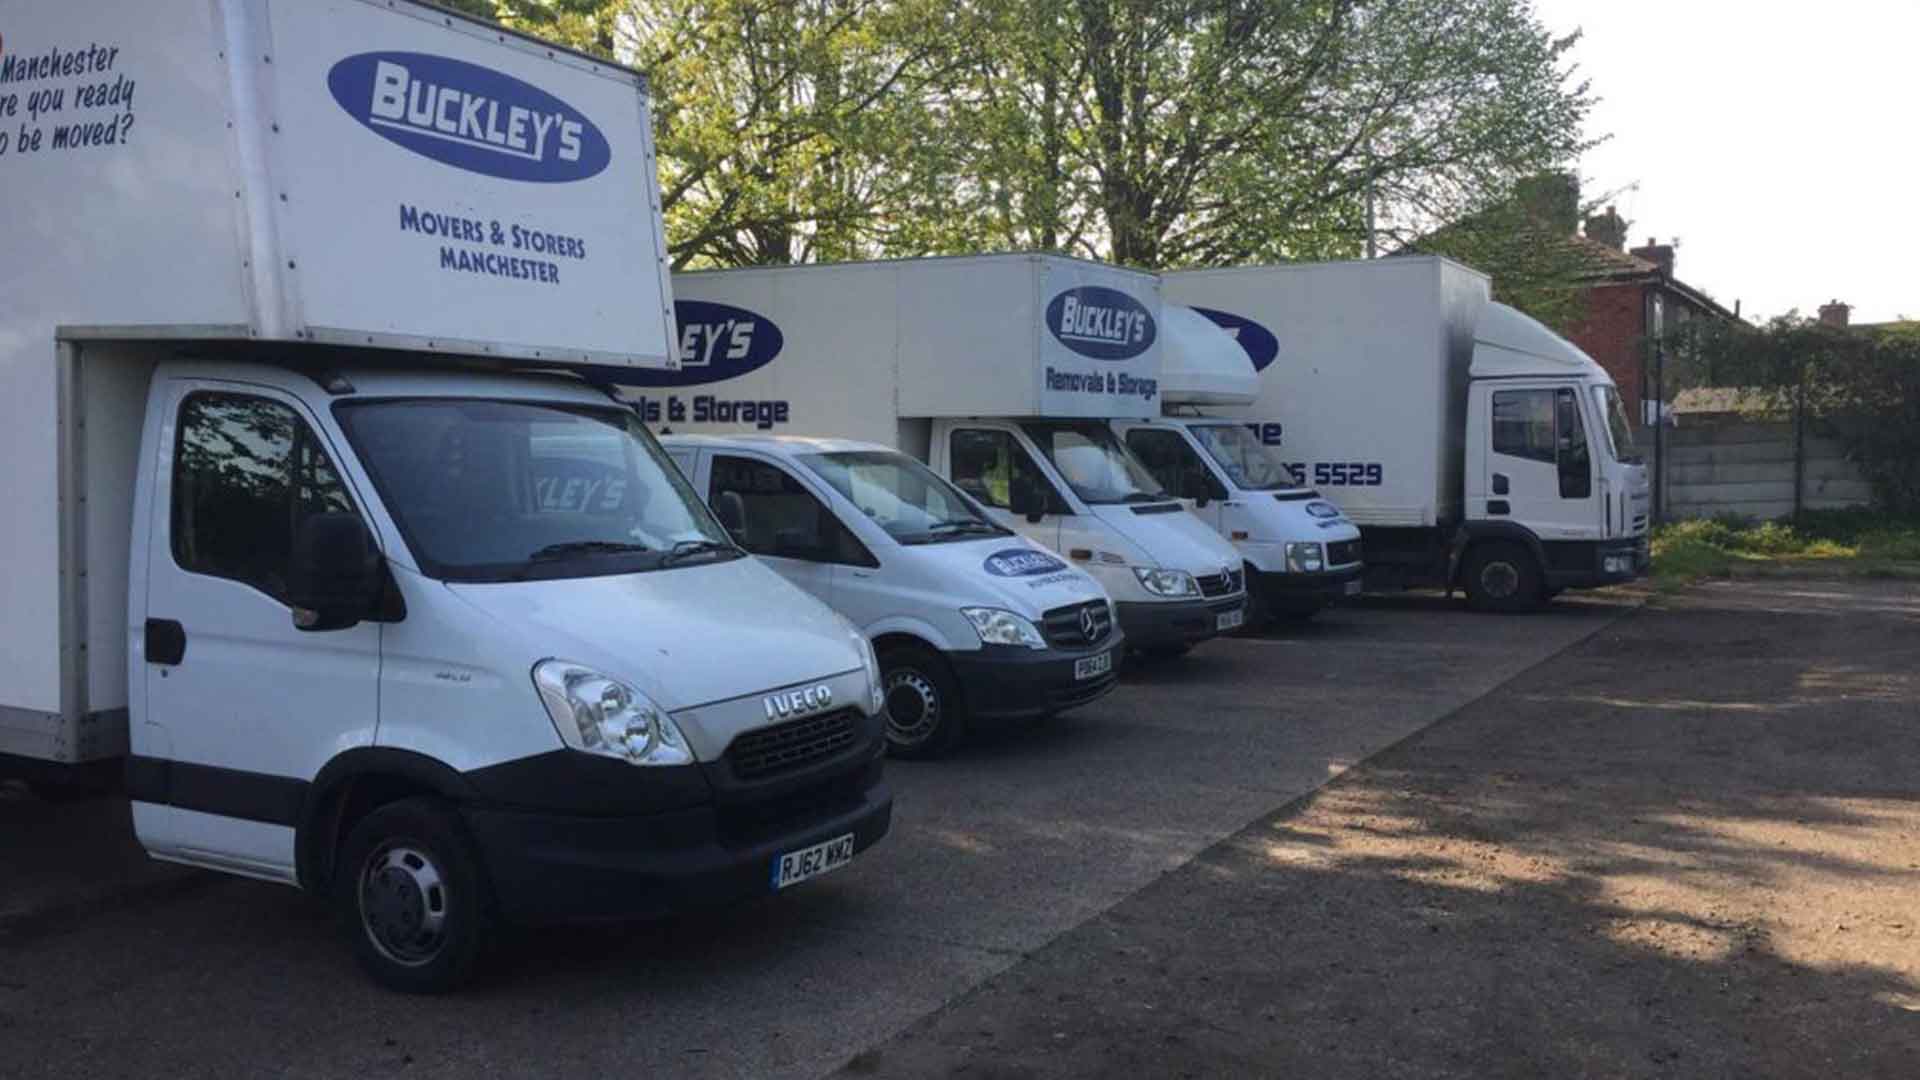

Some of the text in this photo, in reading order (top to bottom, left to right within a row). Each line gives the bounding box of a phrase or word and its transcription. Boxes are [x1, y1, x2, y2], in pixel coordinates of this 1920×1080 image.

[1, 43, 118, 83] Manchester
[28, 89, 64, 121] you
[75, 74, 135, 110] ready
[371, 60, 583, 161] BUCKLEY'S
[18, 124, 42, 152] be
[52, 113, 134, 149] moved?
[400, 203, 586, 260] MOVERS & STORERS
[440, 246, 560, 284] MANCHESTER
[1060, 295, 1146, 345] BUCKLEY'S
[1045, 366, 1104, 394] Removals
[1106, 371, 1116, 394] &
[667, 396, 686, 422] &
[692, 395, 789, 430] Storage
[1314, 462, 1382, 486] 5529
[763, 684, 832, 719] IVECO
[783, 847, 823, 880] RJ62
